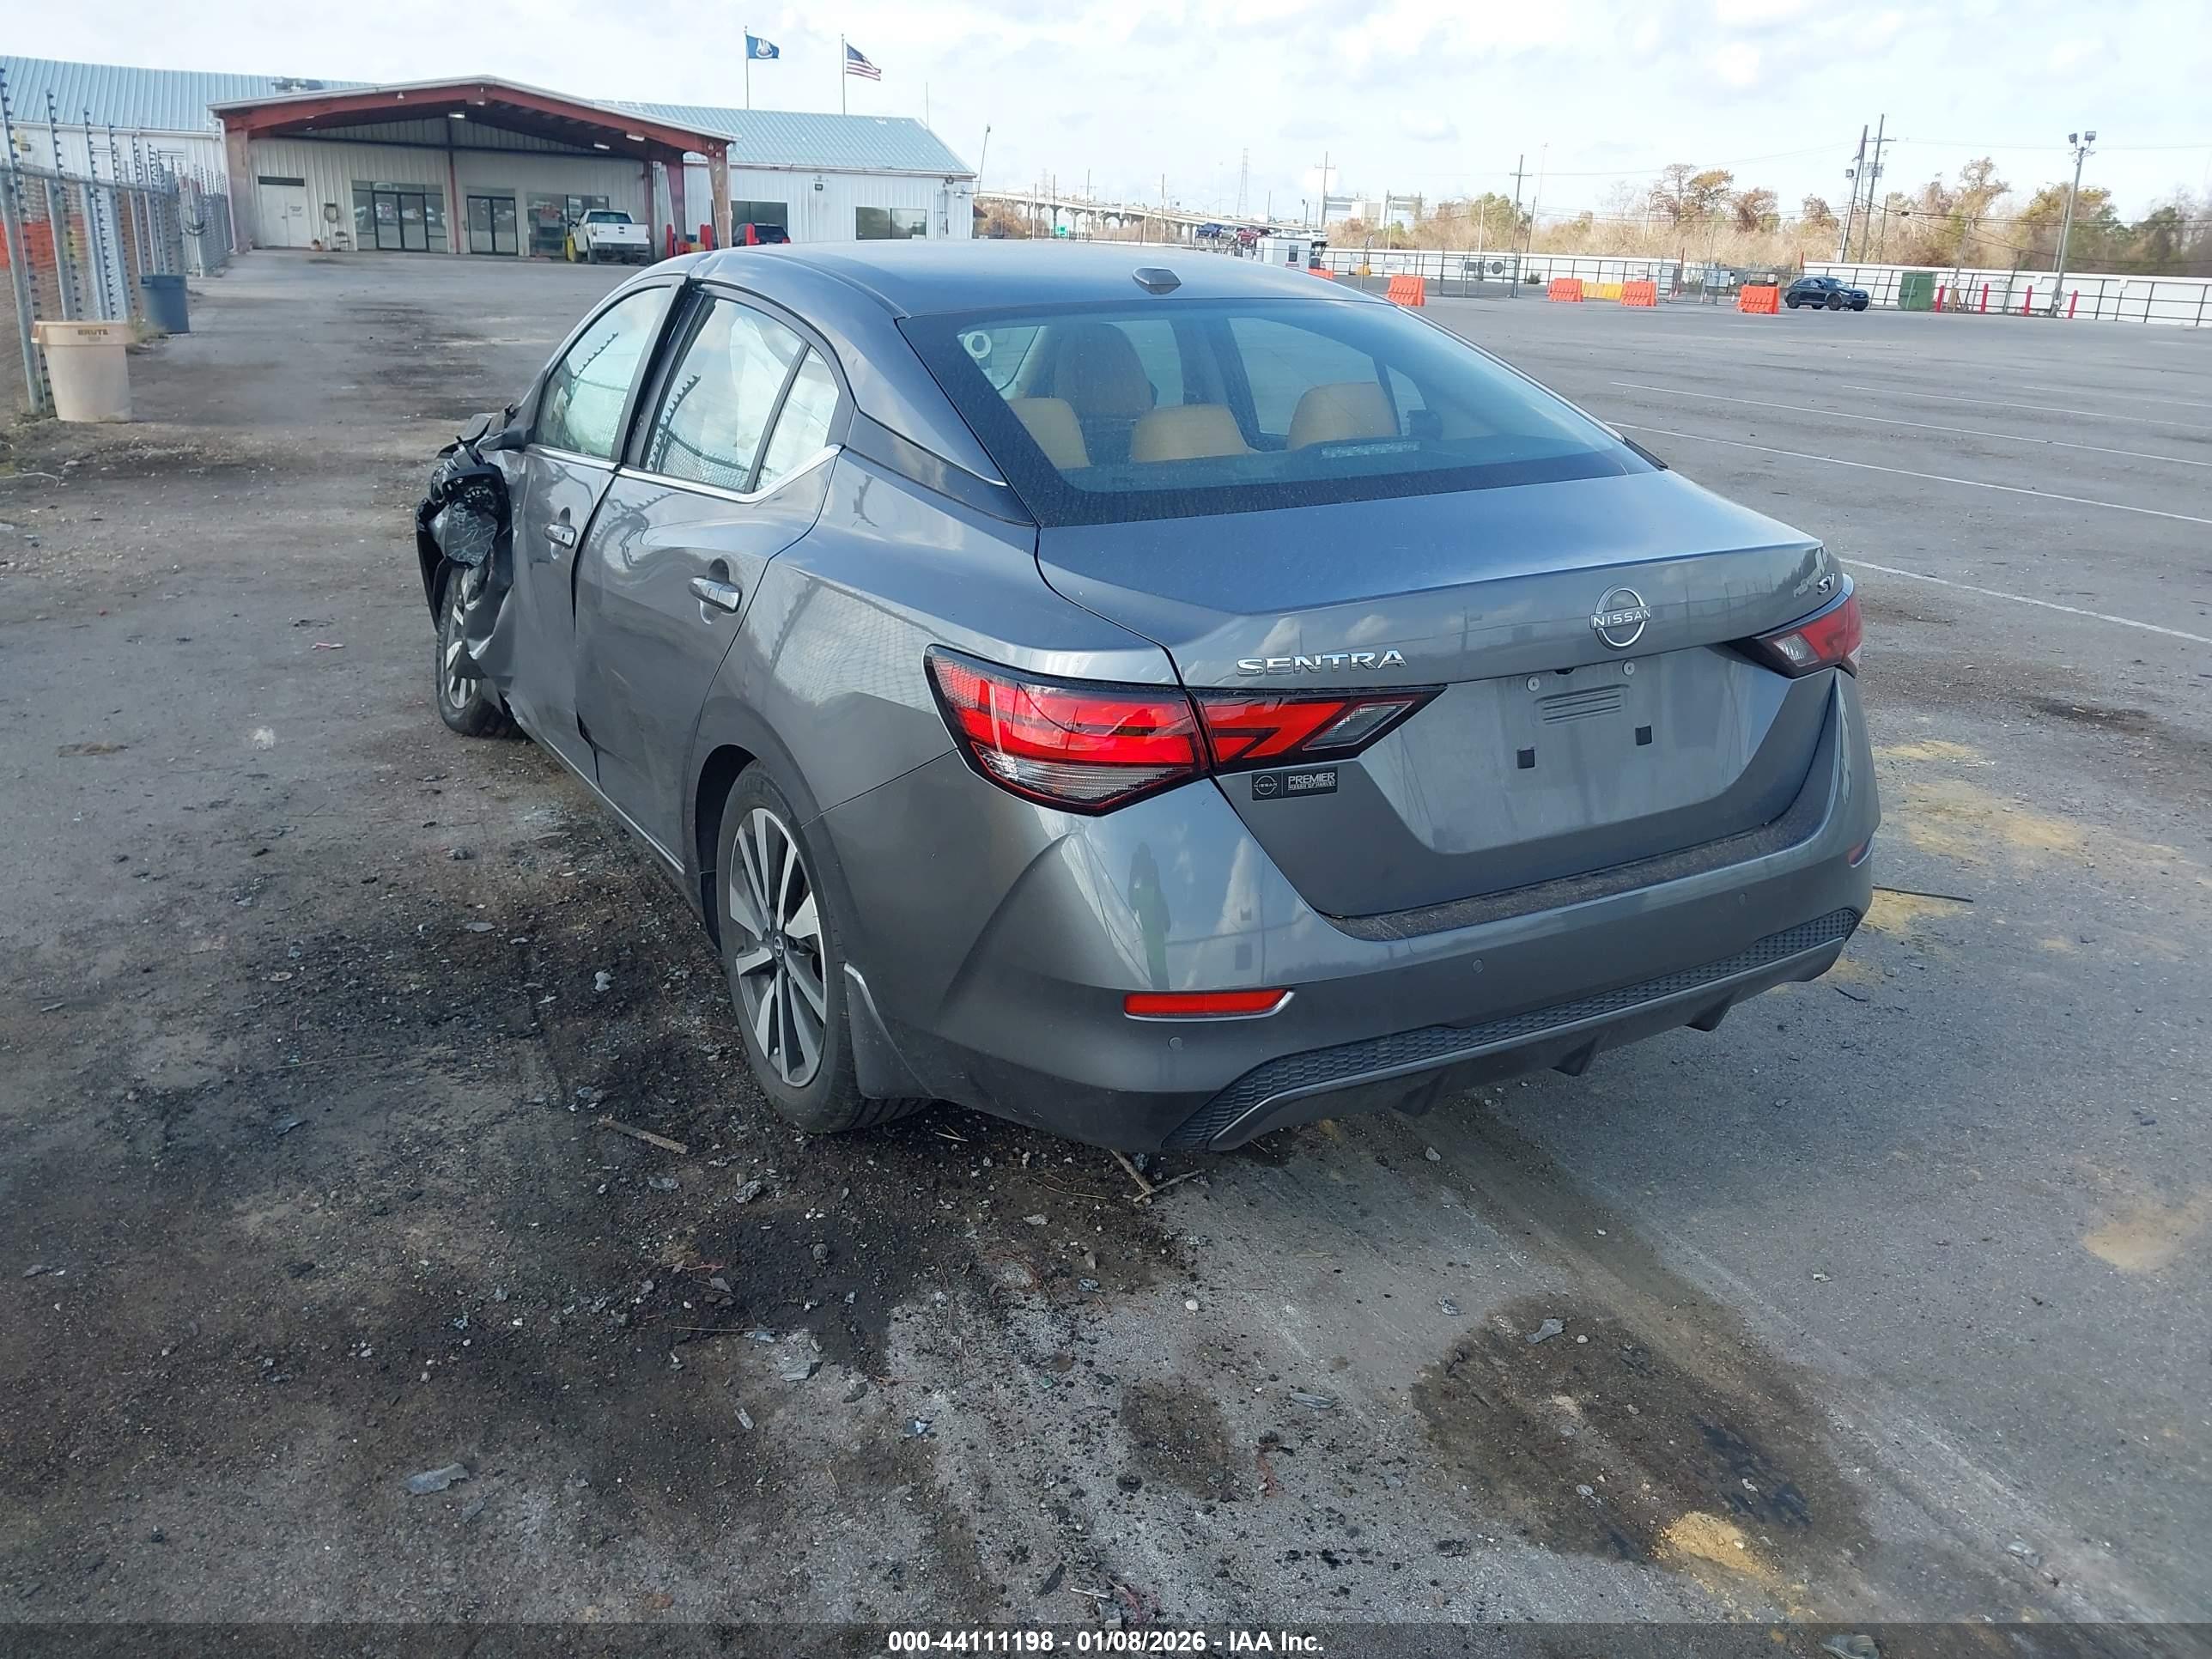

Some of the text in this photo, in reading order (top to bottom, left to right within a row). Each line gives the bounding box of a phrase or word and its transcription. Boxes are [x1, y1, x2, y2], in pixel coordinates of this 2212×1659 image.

[1816, 572, 1836, 594] SV
[1593, 608, 1652, 628] NISSAN
[1237, 649, 1408, 676] SENTRA
[1287, 772, 1335, 785] PREMIER
